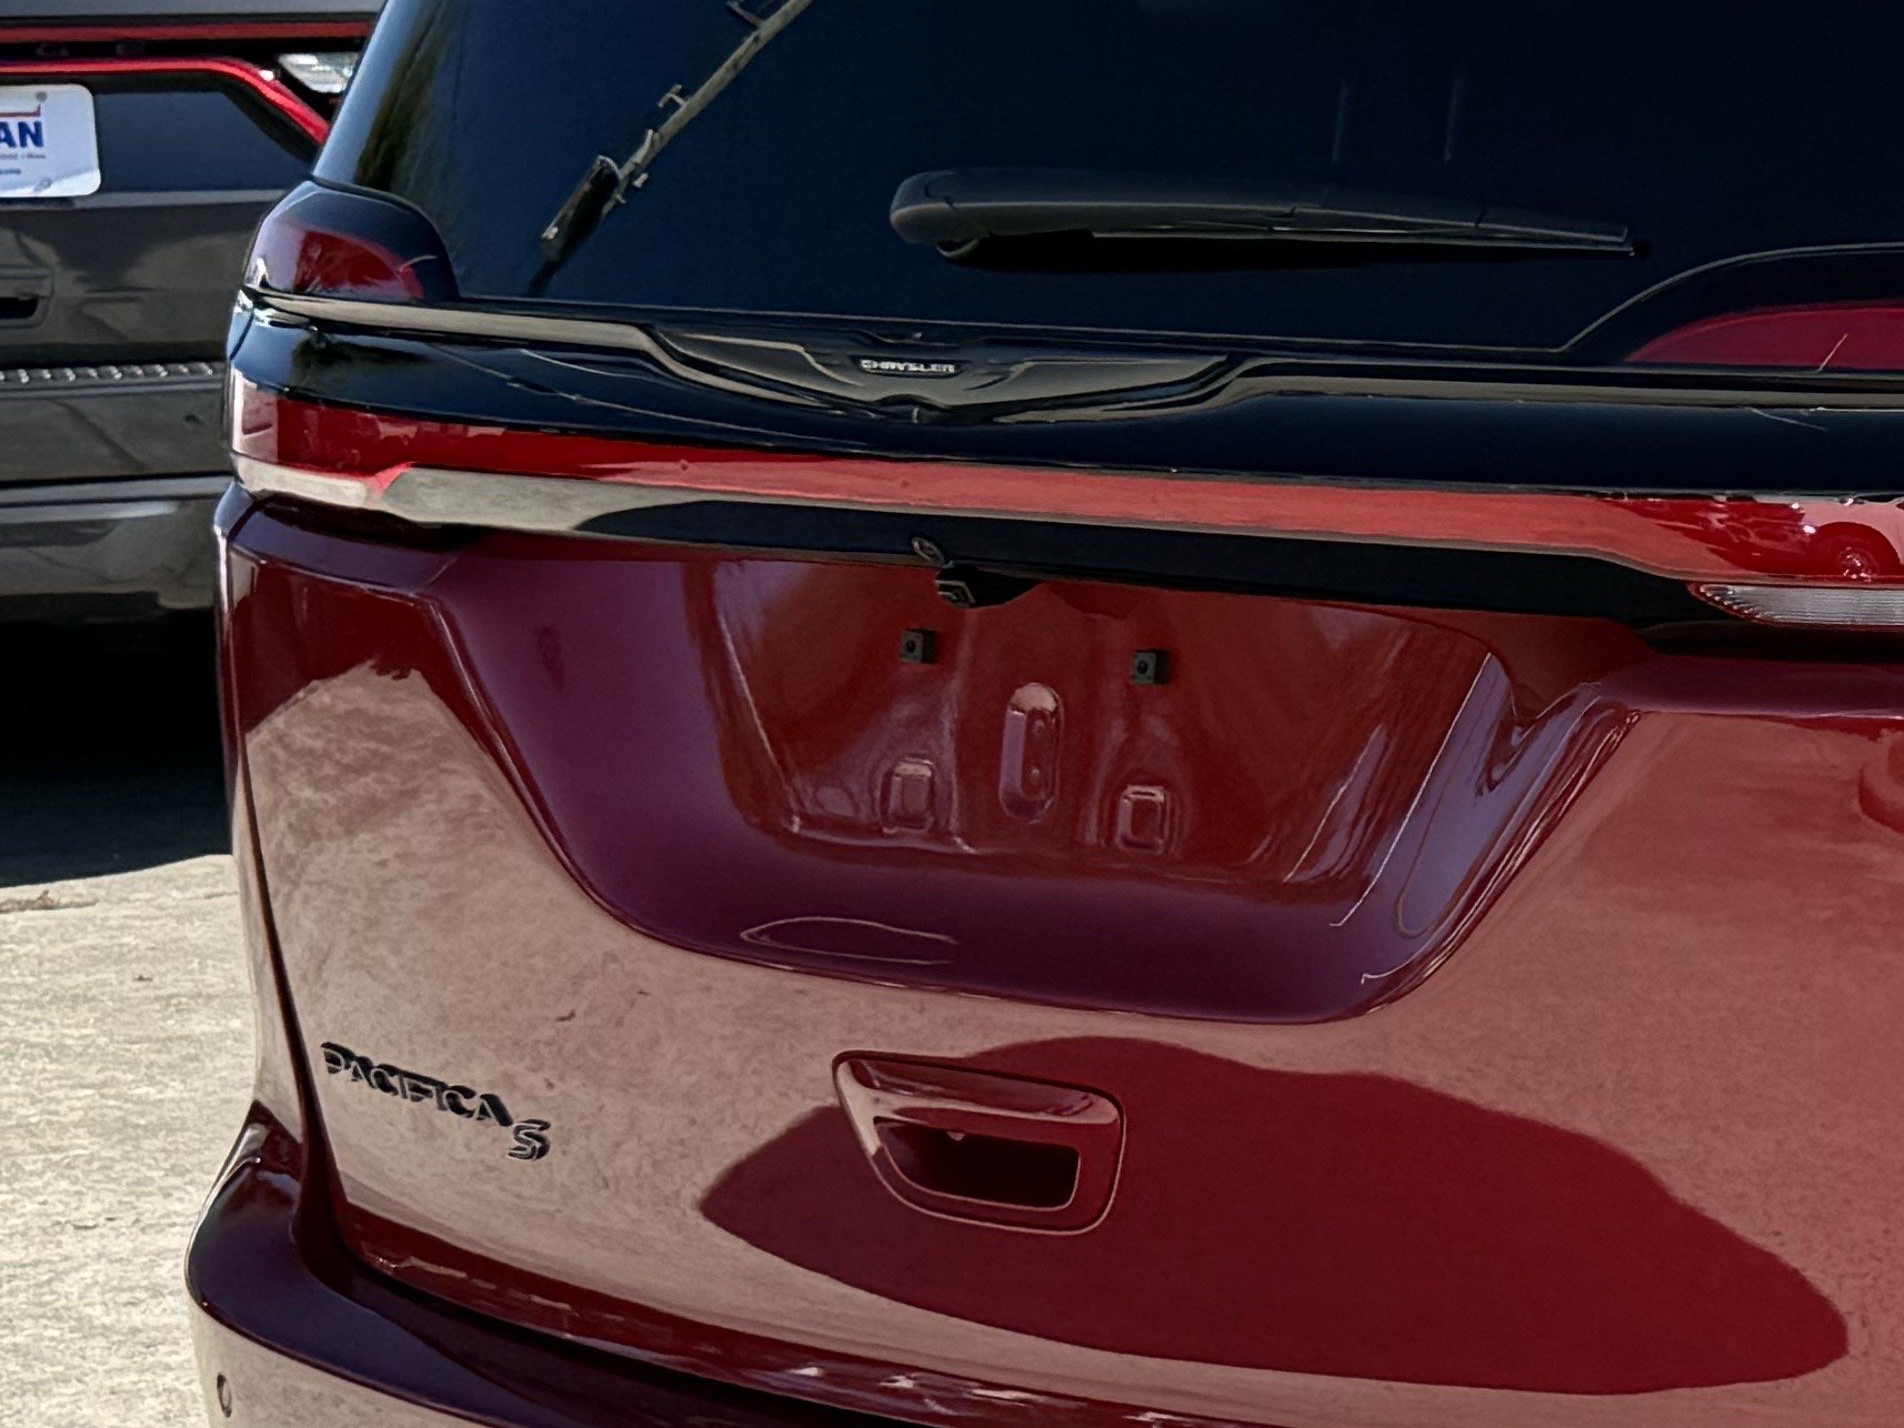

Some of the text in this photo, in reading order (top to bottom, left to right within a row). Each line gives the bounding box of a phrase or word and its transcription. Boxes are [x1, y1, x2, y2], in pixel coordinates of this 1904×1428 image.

[861, 358, 955, 373] CHRYSLER
[320, 1041, 551, 1160] PACIFICA S
